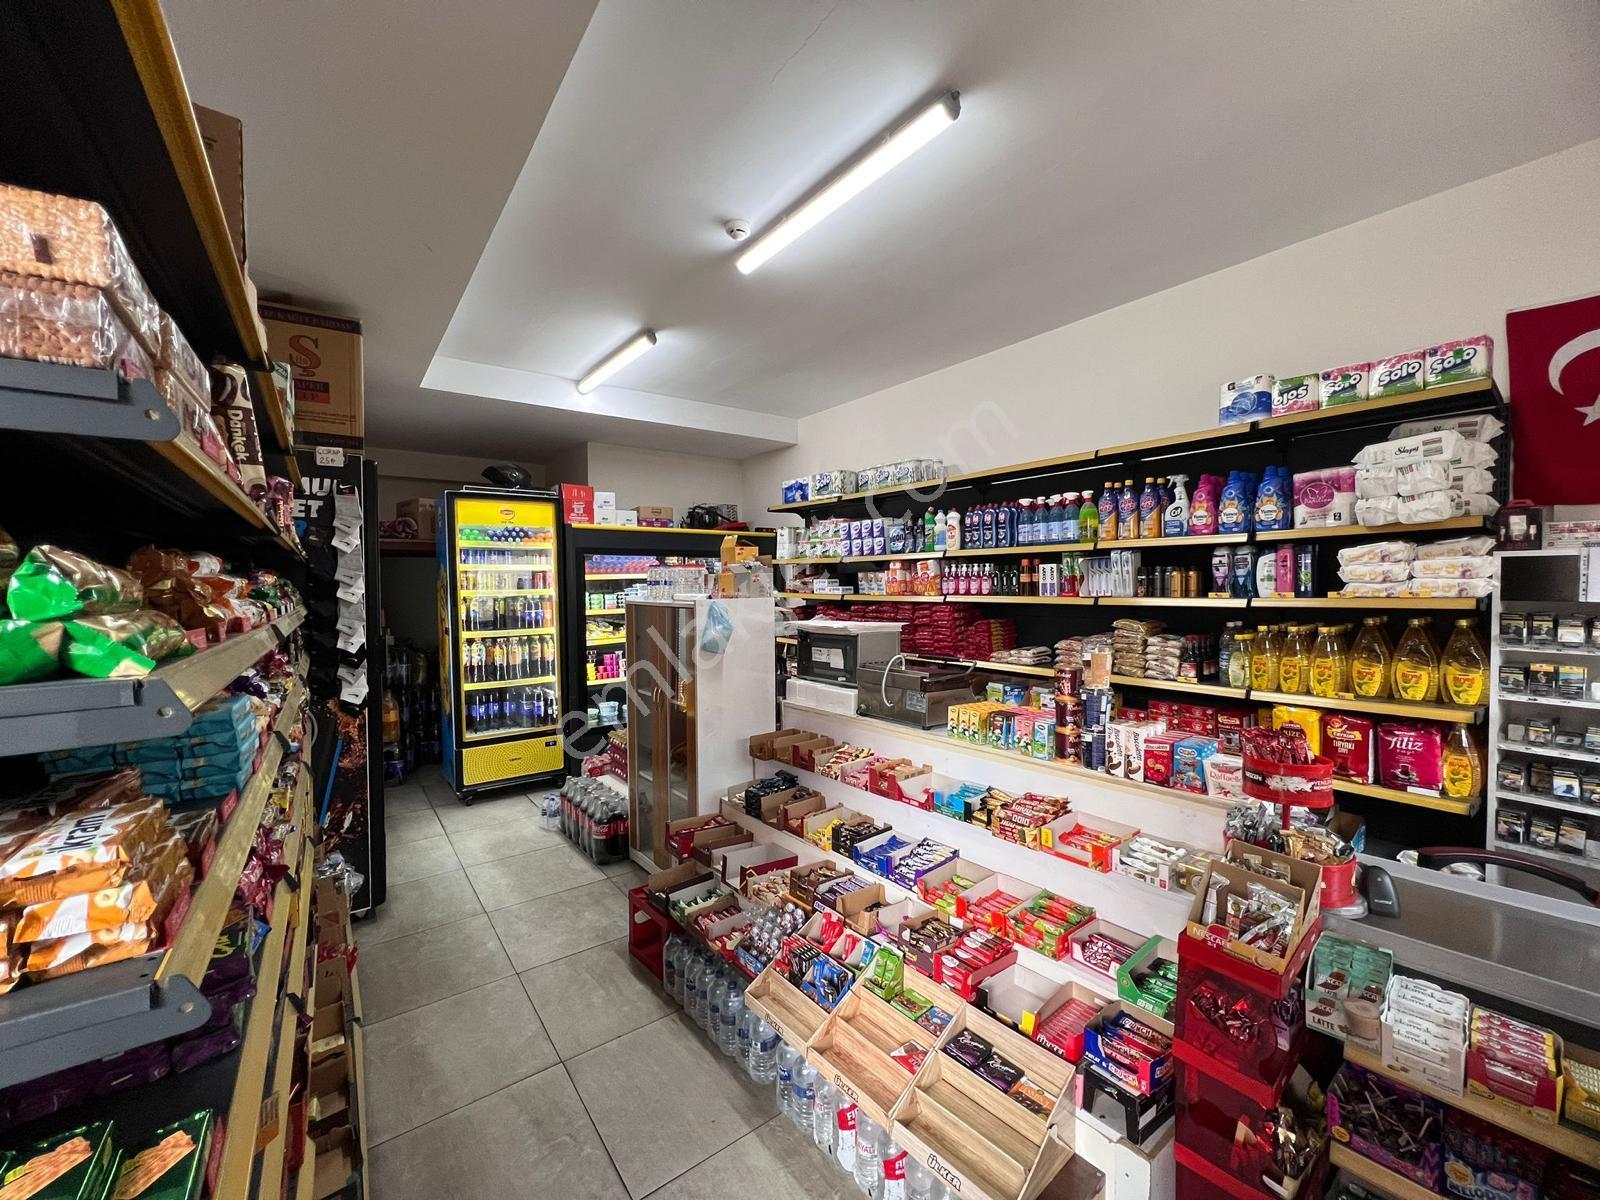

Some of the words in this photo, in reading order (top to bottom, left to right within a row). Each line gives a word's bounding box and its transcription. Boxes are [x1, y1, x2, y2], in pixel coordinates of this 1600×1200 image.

[1378, 361, 1421, 387] Solo
[1209, 771, 1241, 783] Raffaell
[1312, 1015, 1335, 1030] LATTE
[834, 1074, 859, 1103] ÜLKER
[927, 1153, 962, 1193] ÜLKER
